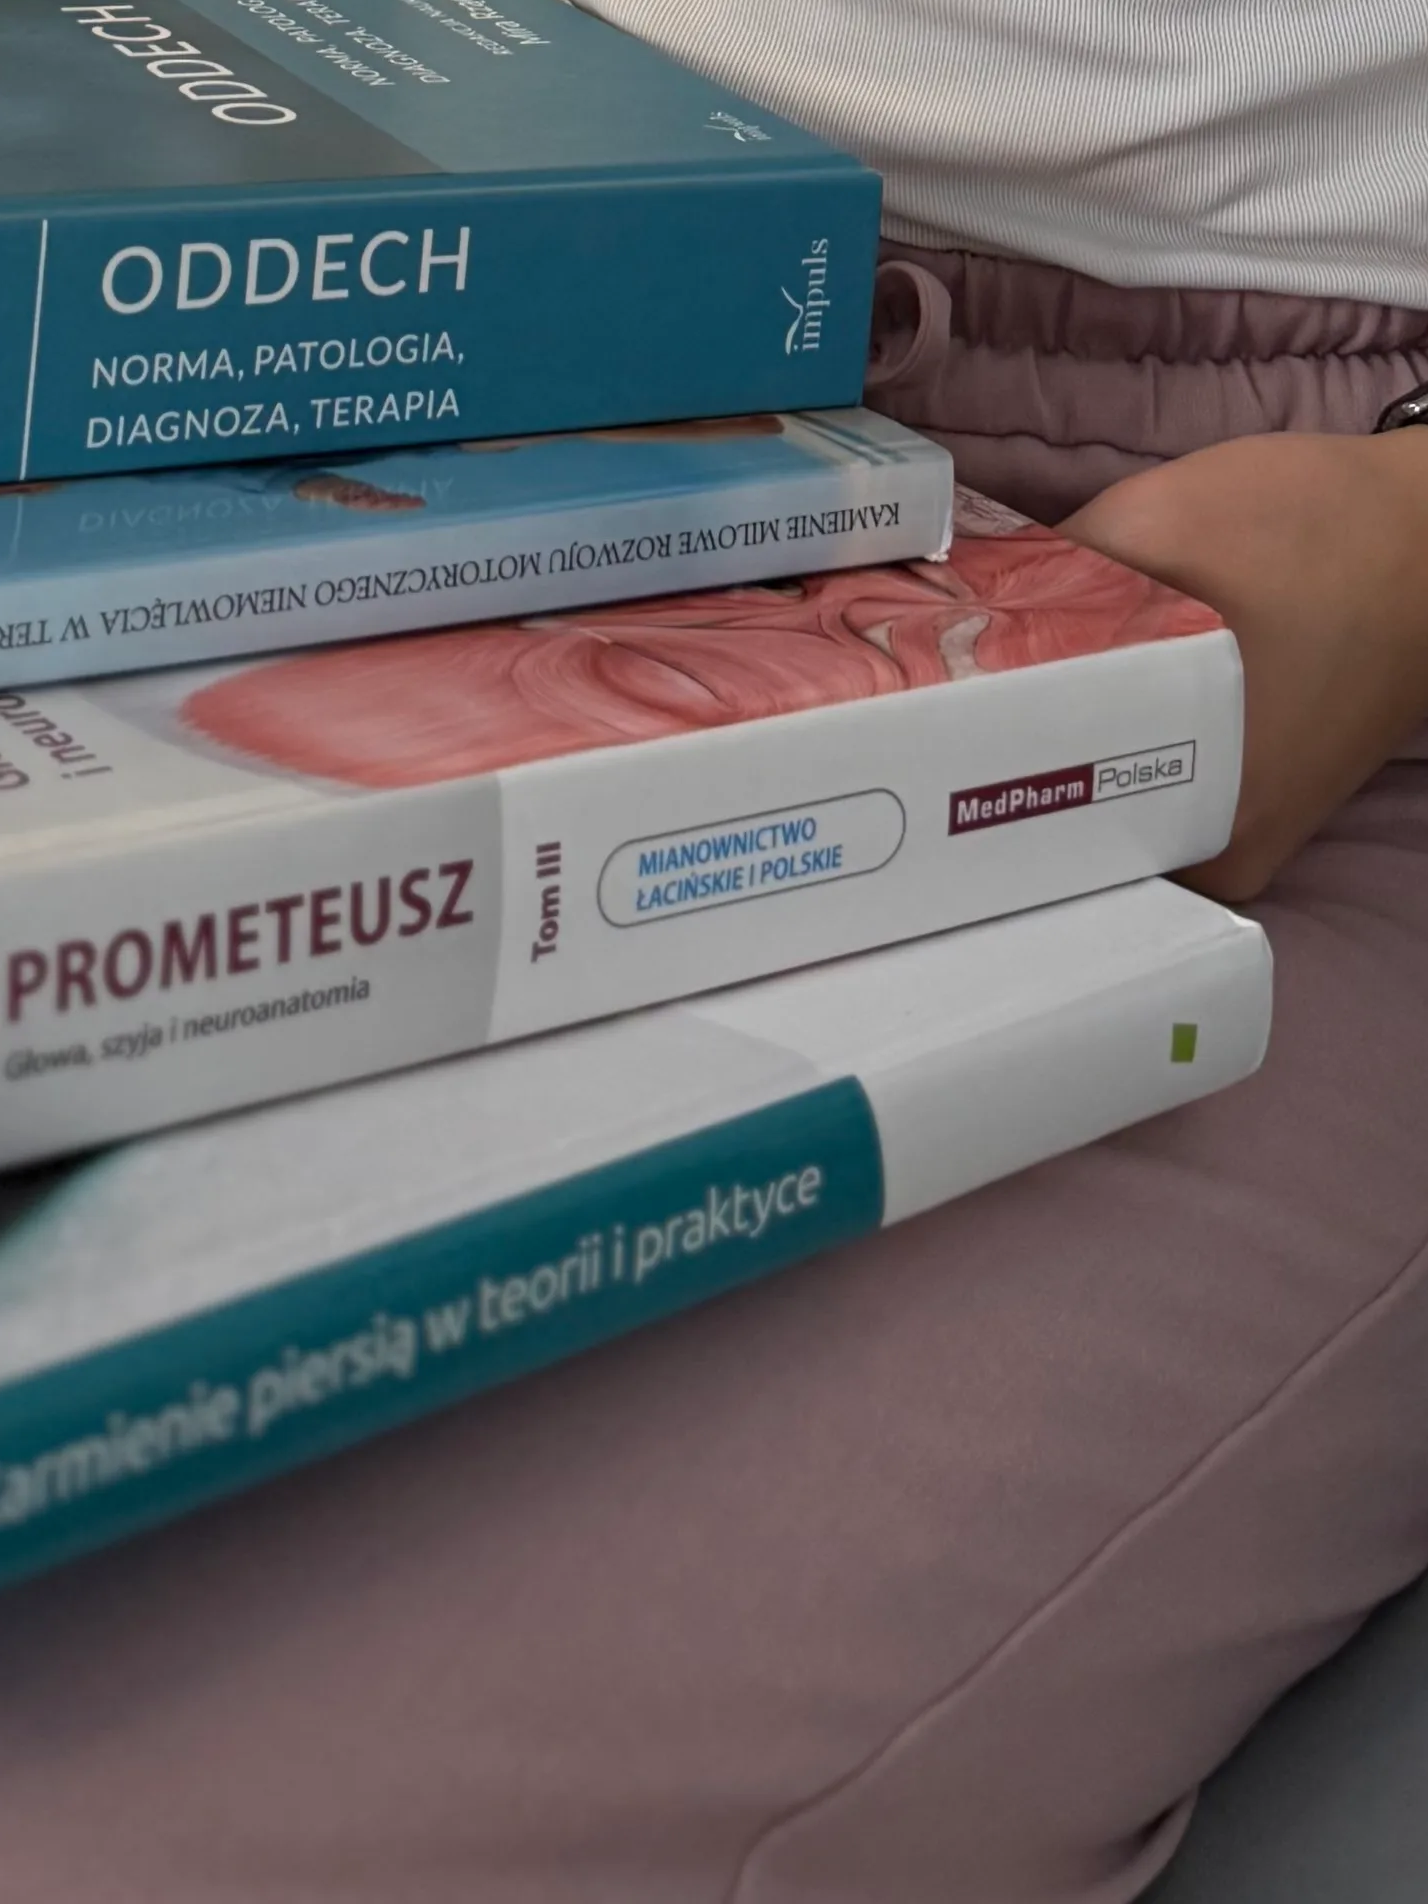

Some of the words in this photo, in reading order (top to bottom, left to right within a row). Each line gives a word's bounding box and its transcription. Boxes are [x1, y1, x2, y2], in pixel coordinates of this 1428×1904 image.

[346, 26, 451, 83] DIAGNOZA,
[495, 21, 552, 46] Mira
[61, 4, 297, 126] ODDECH
[316, 47, 396, 87] NORMA,
[101, 227, 471, 315] ODDECH
[794, 238, 830, 351] impuls
[92, 348, 244, 389] NORMA,
[254, 331, 465, 374] PATOLOGIA,
[85, 405, 301, 448] DIAGNOZA,
[310, 388, 460, 429] TERAPIA
[679, 519, 779, 556] MILOWE
[787, 502, 900, 540] KAMIENIE
[316, 554, 541, 606] MOTORYCZNEGO
[549, 534, 670, 571] ROZWOJU
[60, 615, 90, 640] W
[101, 584, 307, 639] NIEMOWLĘCIA
[62, 765, 112, 779] i
[957, 777, 1085, 825] MedPharm
[1098, 753, 1183, 793] Polska
[536, 841, 561, 880] III
[638, 816, 817, 878] MIANOWNICTWO
[636, 871, 744, 911] ŁACIŃSKIE
[748, 866, 755, 886] I
[759, 844, 842, 882] POLSKIE
[6, 859, 474, 1025] PROMETEUSZ
[531, 889, 561, 964] Tom
[4, 1042, 92, 1082] Głowa,
[101, 1023, 163, 1059] szyja
[169, 1020, 177, 1043] i
[184, 975, 370, 1040] neuroanatomia
[247, 1313, 416, 1438] piersią
[424, 1303, 467, 1351] w
[477, 1233, 600, 1332] teorii
[613, 1227, 623, 1281] i
[635, 1162, 822, 1282] praktyce
